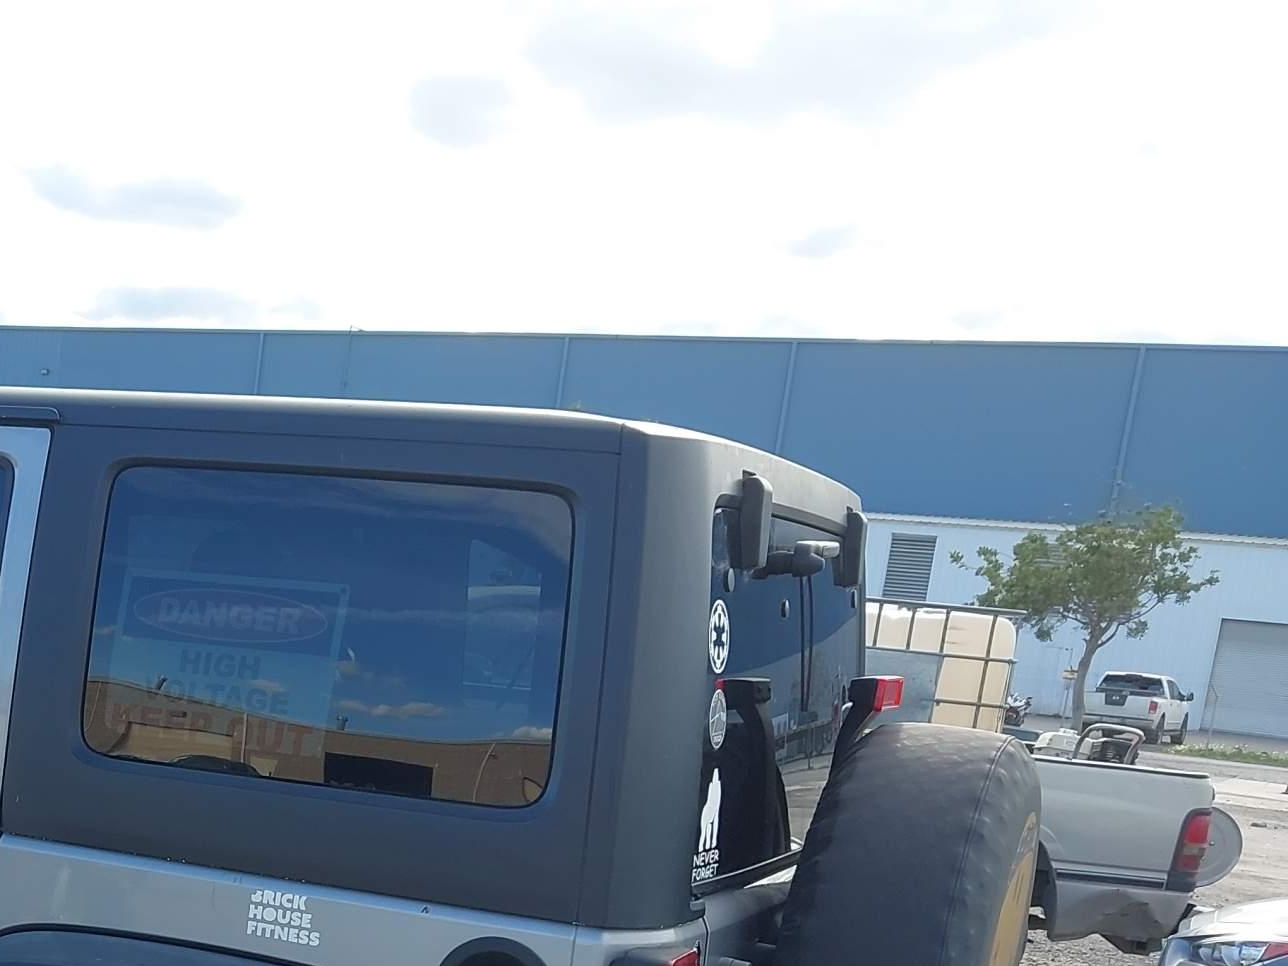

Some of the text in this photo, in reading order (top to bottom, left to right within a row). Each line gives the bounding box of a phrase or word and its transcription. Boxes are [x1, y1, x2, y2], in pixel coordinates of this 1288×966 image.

[158, 597, 306, 634] DANGER
[178, 649, 263, 680] HIGH
[693, 849, 719, 868] NEVER
[691, 863, 719, 882] FORGET
[248, 904, 312, 929] HOUSE
[246, 920, 321, 947] FITNESS
